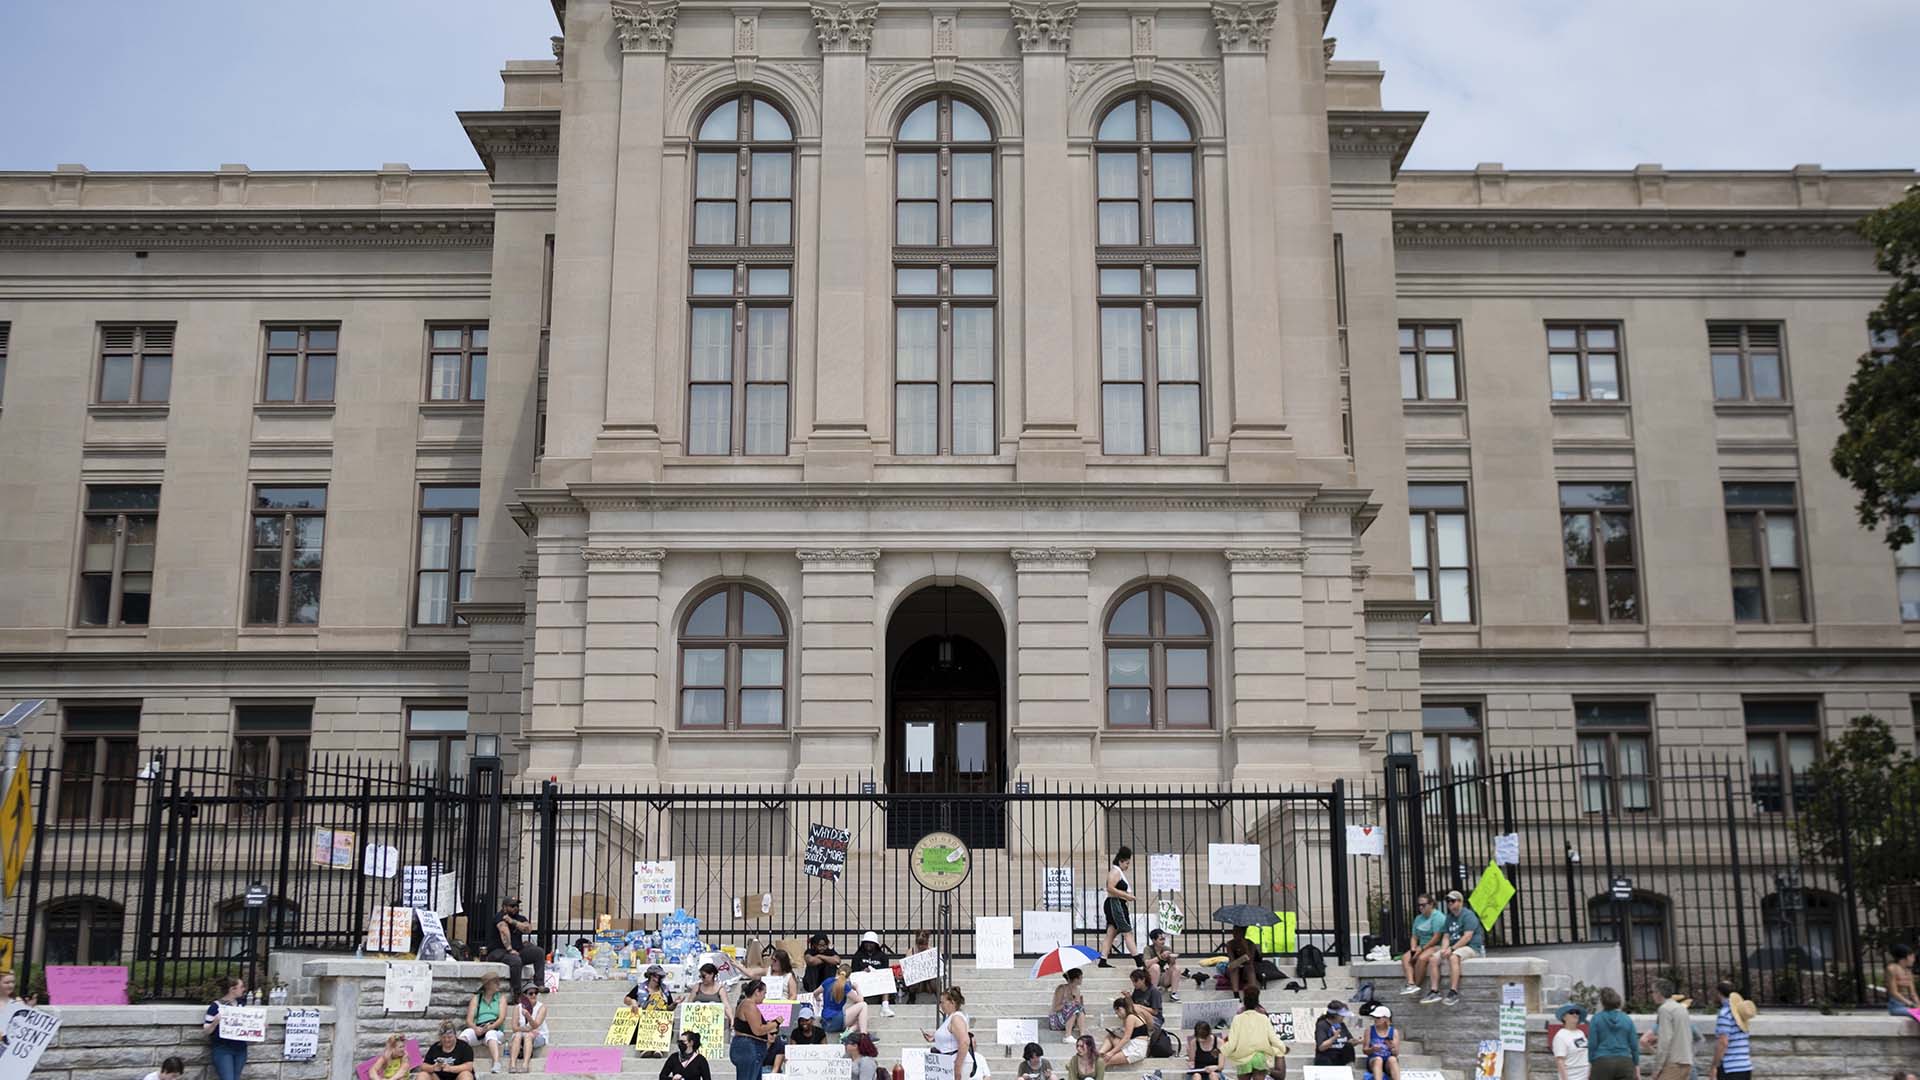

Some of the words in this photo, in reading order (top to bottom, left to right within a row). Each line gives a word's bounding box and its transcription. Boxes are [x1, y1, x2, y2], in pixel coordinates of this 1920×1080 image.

[813, 825, 831, 838] WHY
[827, 848, 846, 862] MORE
[25, 1009, 59, 1032] RUTH
[684, 1014, 719, 1023] CHURCH
[16, 1026, 49, 1047] SENT
[613, 1026, 629, 1034] SAFE
[12, 1041, 34, 1059] US
